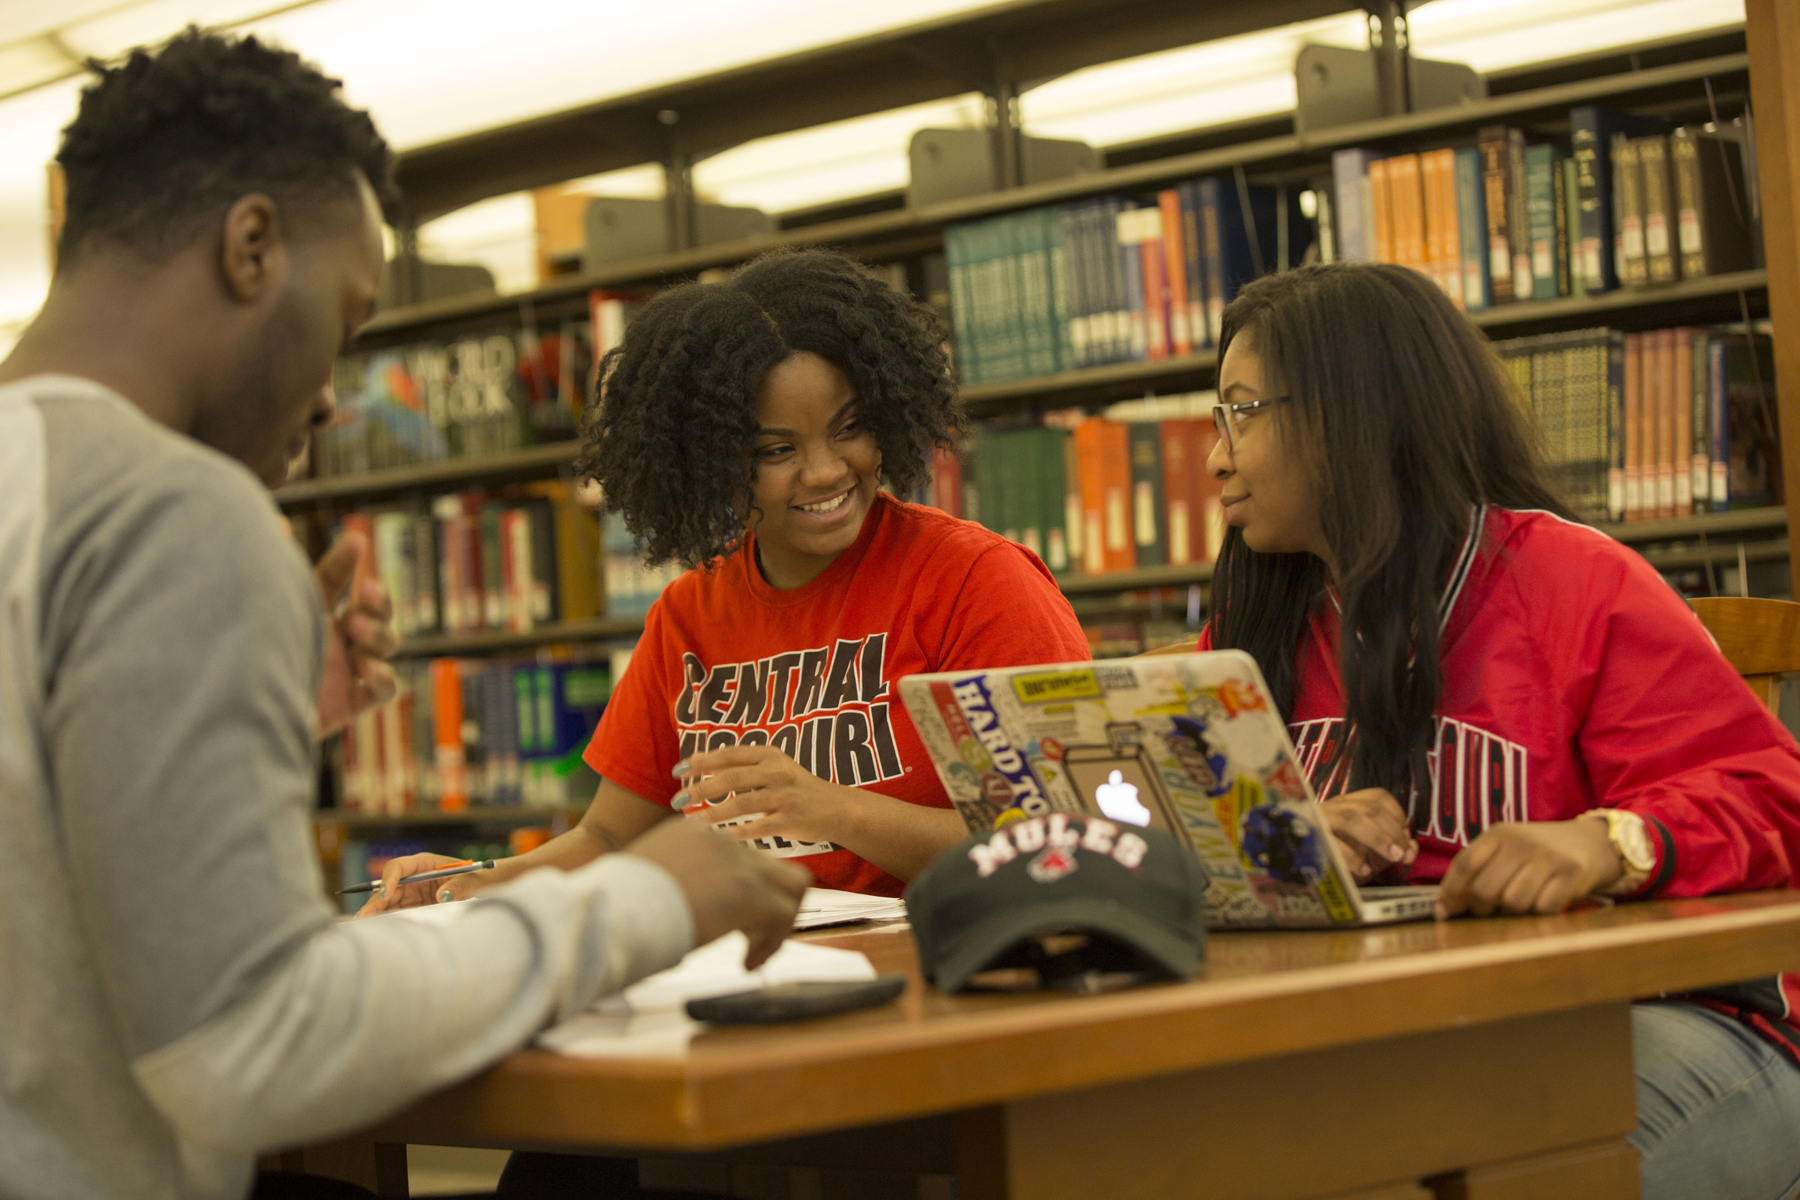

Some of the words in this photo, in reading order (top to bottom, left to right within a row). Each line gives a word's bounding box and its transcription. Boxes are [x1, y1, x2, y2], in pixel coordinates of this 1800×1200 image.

[675, 632, 890, 727] CENTRAL
[953, 680, 1023, 774] HARD
[1011, 775, 1050, 818] TO
[968, 812, 1149, 878] MULES
